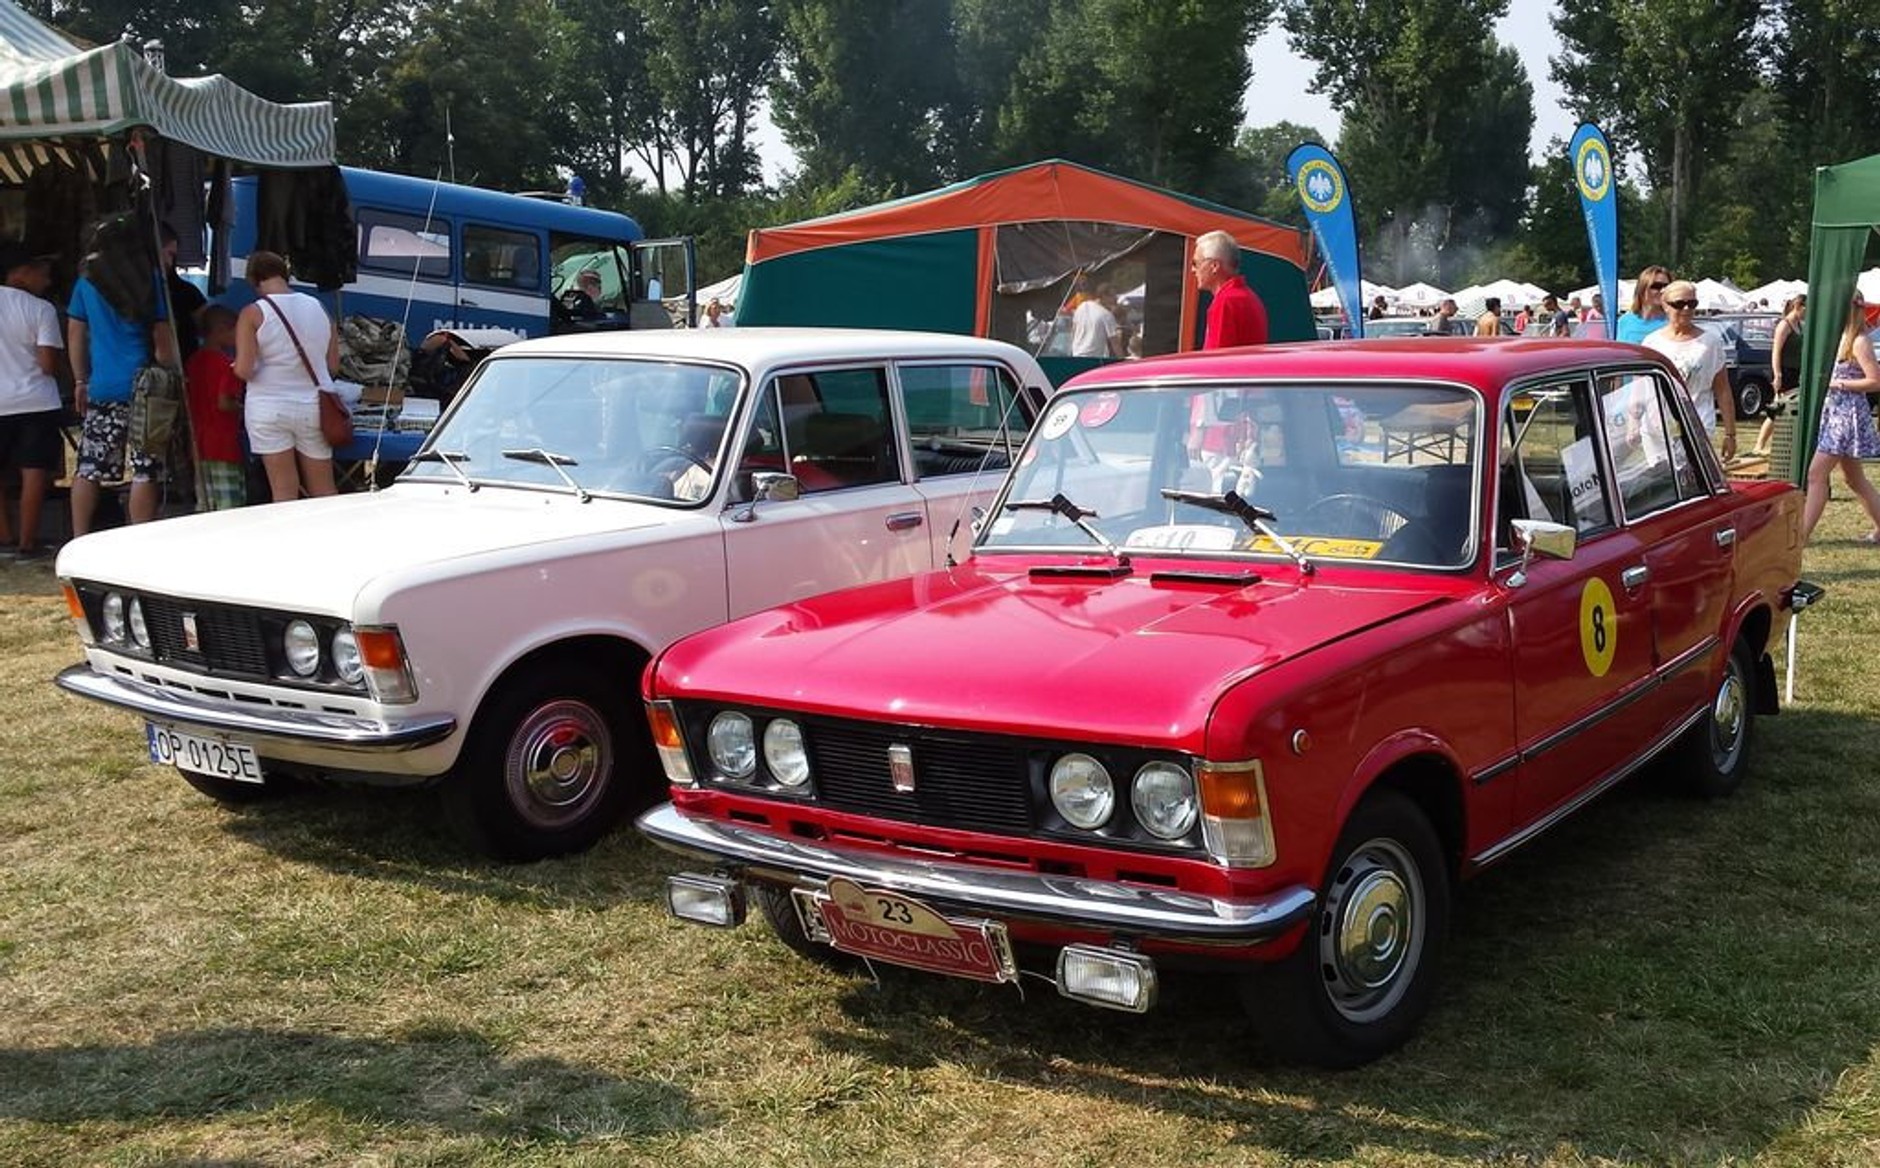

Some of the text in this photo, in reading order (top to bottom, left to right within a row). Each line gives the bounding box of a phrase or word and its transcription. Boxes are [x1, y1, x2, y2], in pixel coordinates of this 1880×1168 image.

[1592, 604, 1606, 653] 8
[158, 731, 258, 778] OP 0125E
[877, 899, 914, 925] 23
[829, 914, 990, 967] MOTOCLASSIC
